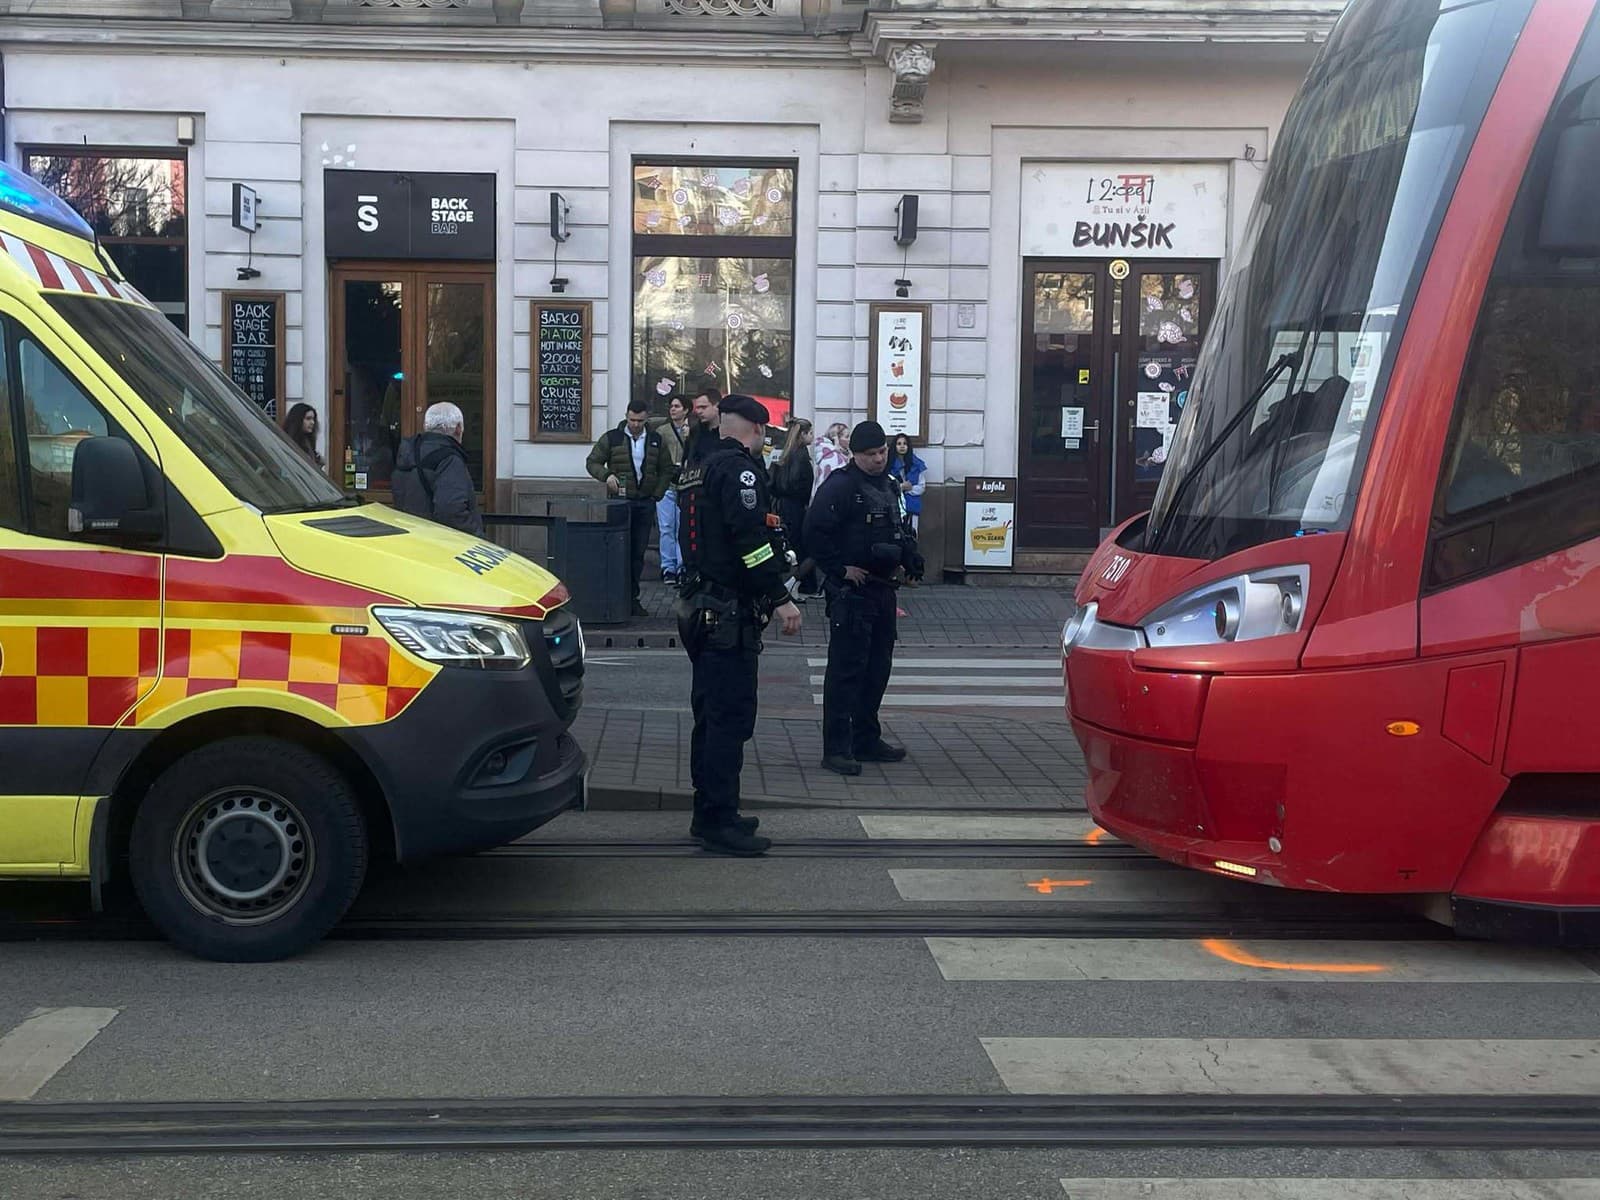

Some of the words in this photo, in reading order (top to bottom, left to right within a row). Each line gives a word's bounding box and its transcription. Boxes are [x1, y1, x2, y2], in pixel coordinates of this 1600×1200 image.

[431, 198, 468, 210] BACK
[1102, 206, 1113, 214] Tu
[1116, 206, 1124, 214] si
[431, 210, 474, 222] STAGE
[431, 222, 458, 234] BAR
[1072, 214, 1176, 249] BUNŠIK
[235, 303, 271, 319] BACK
[233, 319, 270, 332] STAGE
[236, 331, 268, 344] BAR
[541, 328, 582, 340] PIATOK
[541, 341, 556, 350] HOT
[556, 341, 564, 350] IN
[541, 364, 579, 373] PARTY
[541, 386, 582, 398] CRUISE
[982, 481, 1006, 493] kofola
[1101, 555, 1131, 583] 7510
